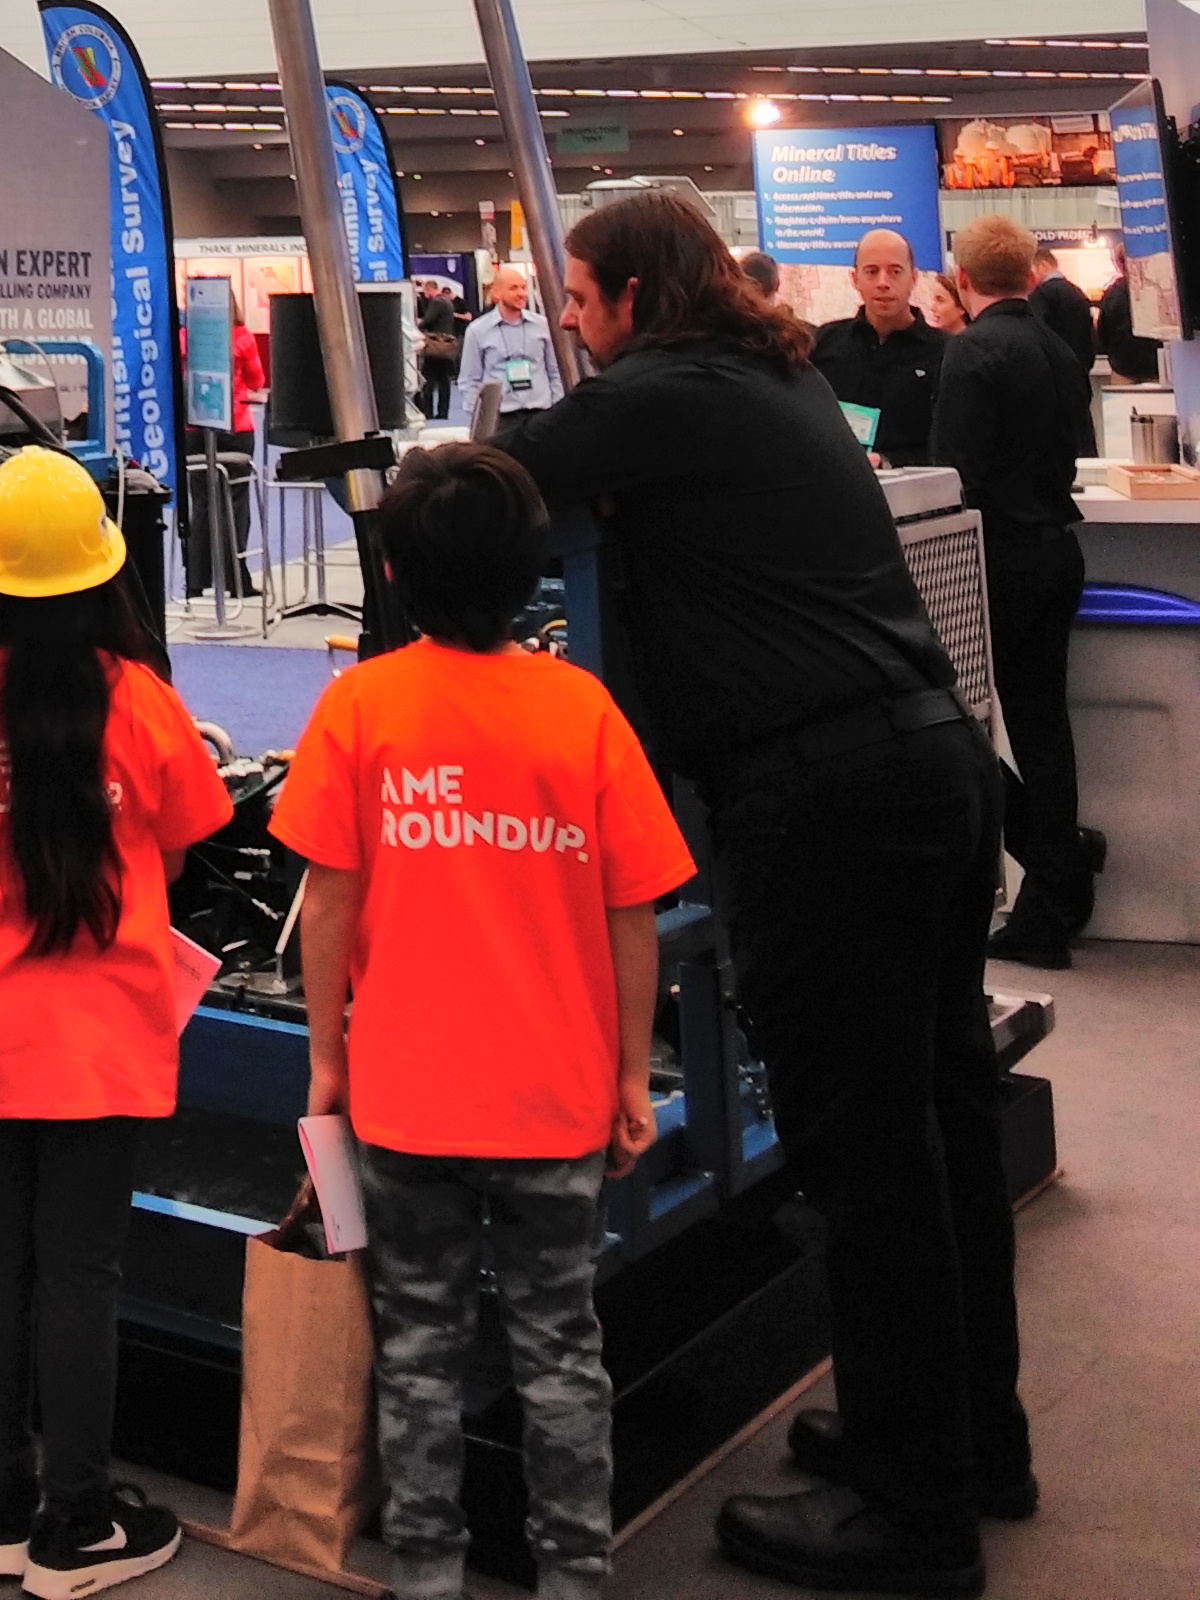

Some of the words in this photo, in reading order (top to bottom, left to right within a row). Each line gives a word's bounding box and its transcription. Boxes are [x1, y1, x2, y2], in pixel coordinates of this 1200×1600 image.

[771, 143, 844, 162] Mineral
[846, 143, 898, 161] Titles
[111, 119, 145, 254] Survey
[772, 165, 836, 184] Online
[360, 157, 385, 253] Survey
[198, 244, 232, 253] THANE
[235, 243, 288, 253] MINERALS
[16, 249, 91, 277] EXPERT
[37, 283, 91, 299] COMPANY
[23, 308, 34, 329] A
[37, 308, 94, 329] GLOBAL
[125, 265, 170, 481] Geological
[381, 765, 464, 805] AME
